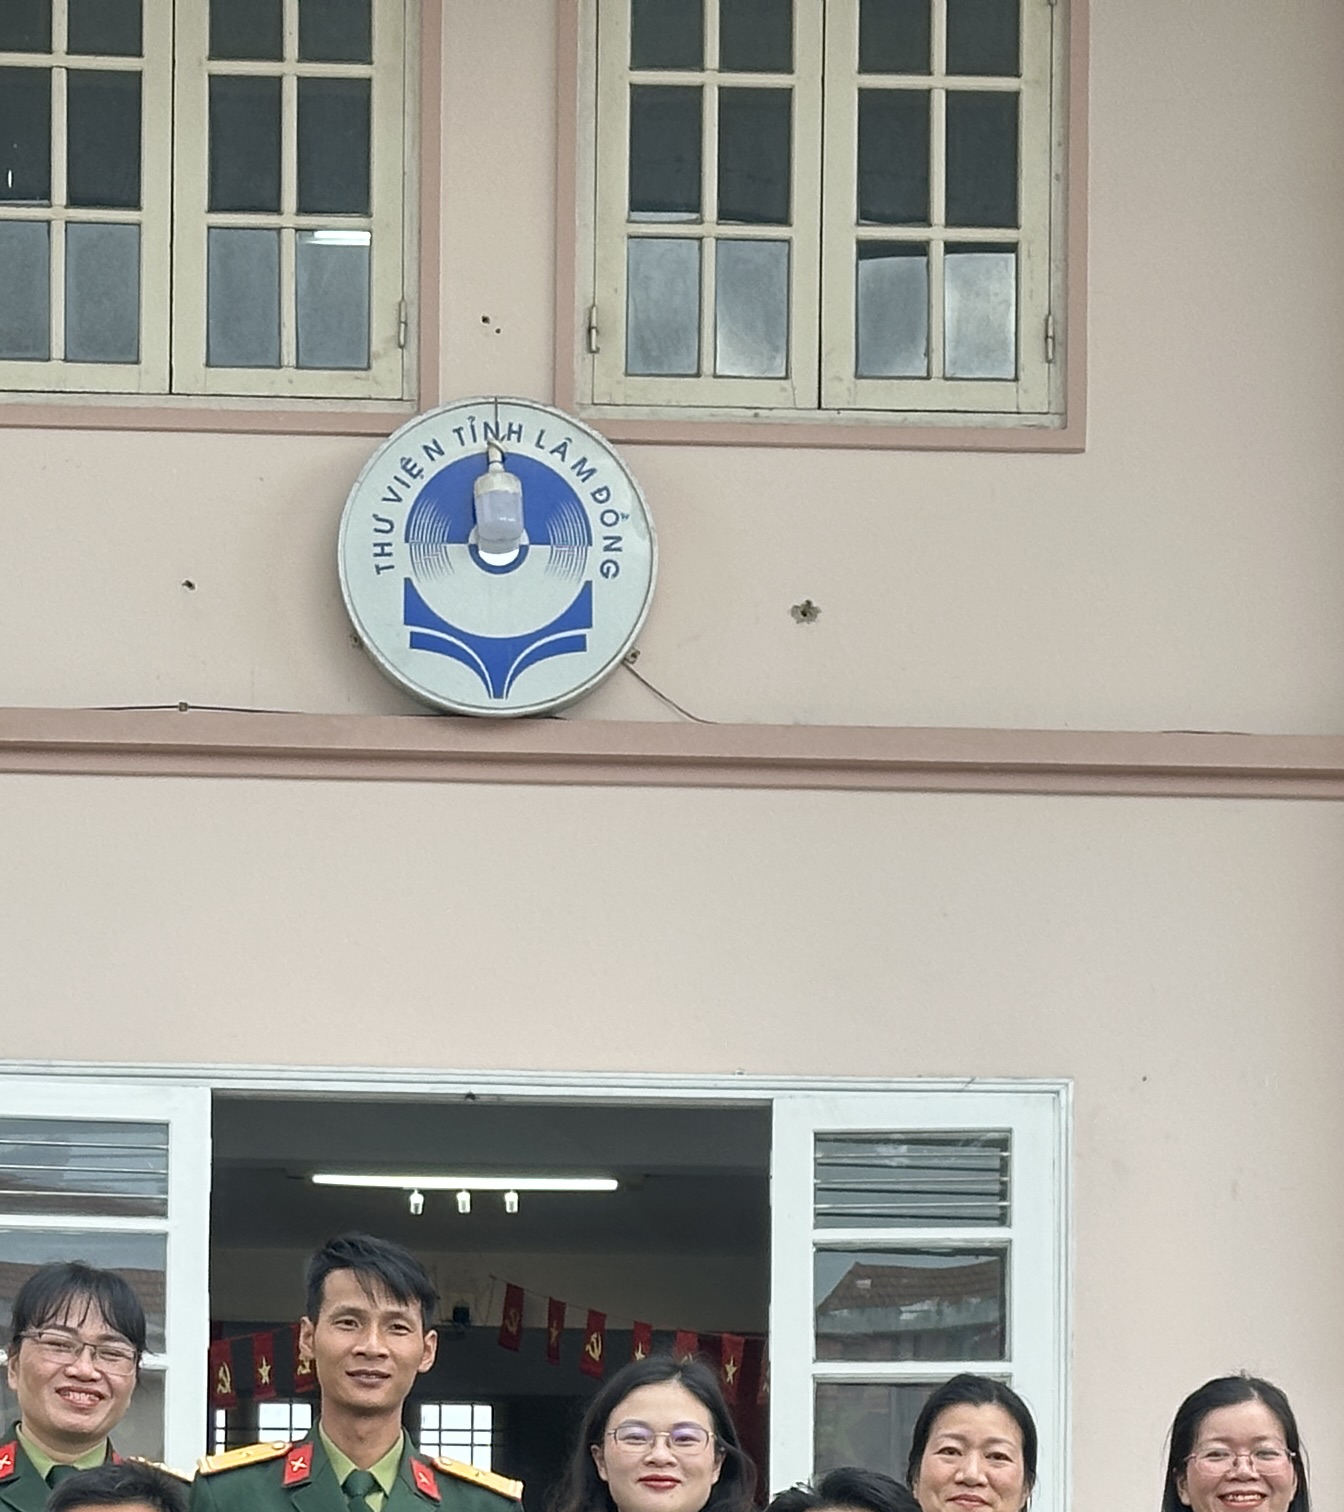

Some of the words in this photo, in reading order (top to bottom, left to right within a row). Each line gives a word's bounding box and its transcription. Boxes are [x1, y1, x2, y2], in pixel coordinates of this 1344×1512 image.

[453, 415, 524, 448] TỈNH
[535, 429, 598, 484] LÂM
[382, 438, 446, 504] VIỆN
[373, 513, 395, 575] THƯ
[590, 485, 630, 580] ĐỒNG
